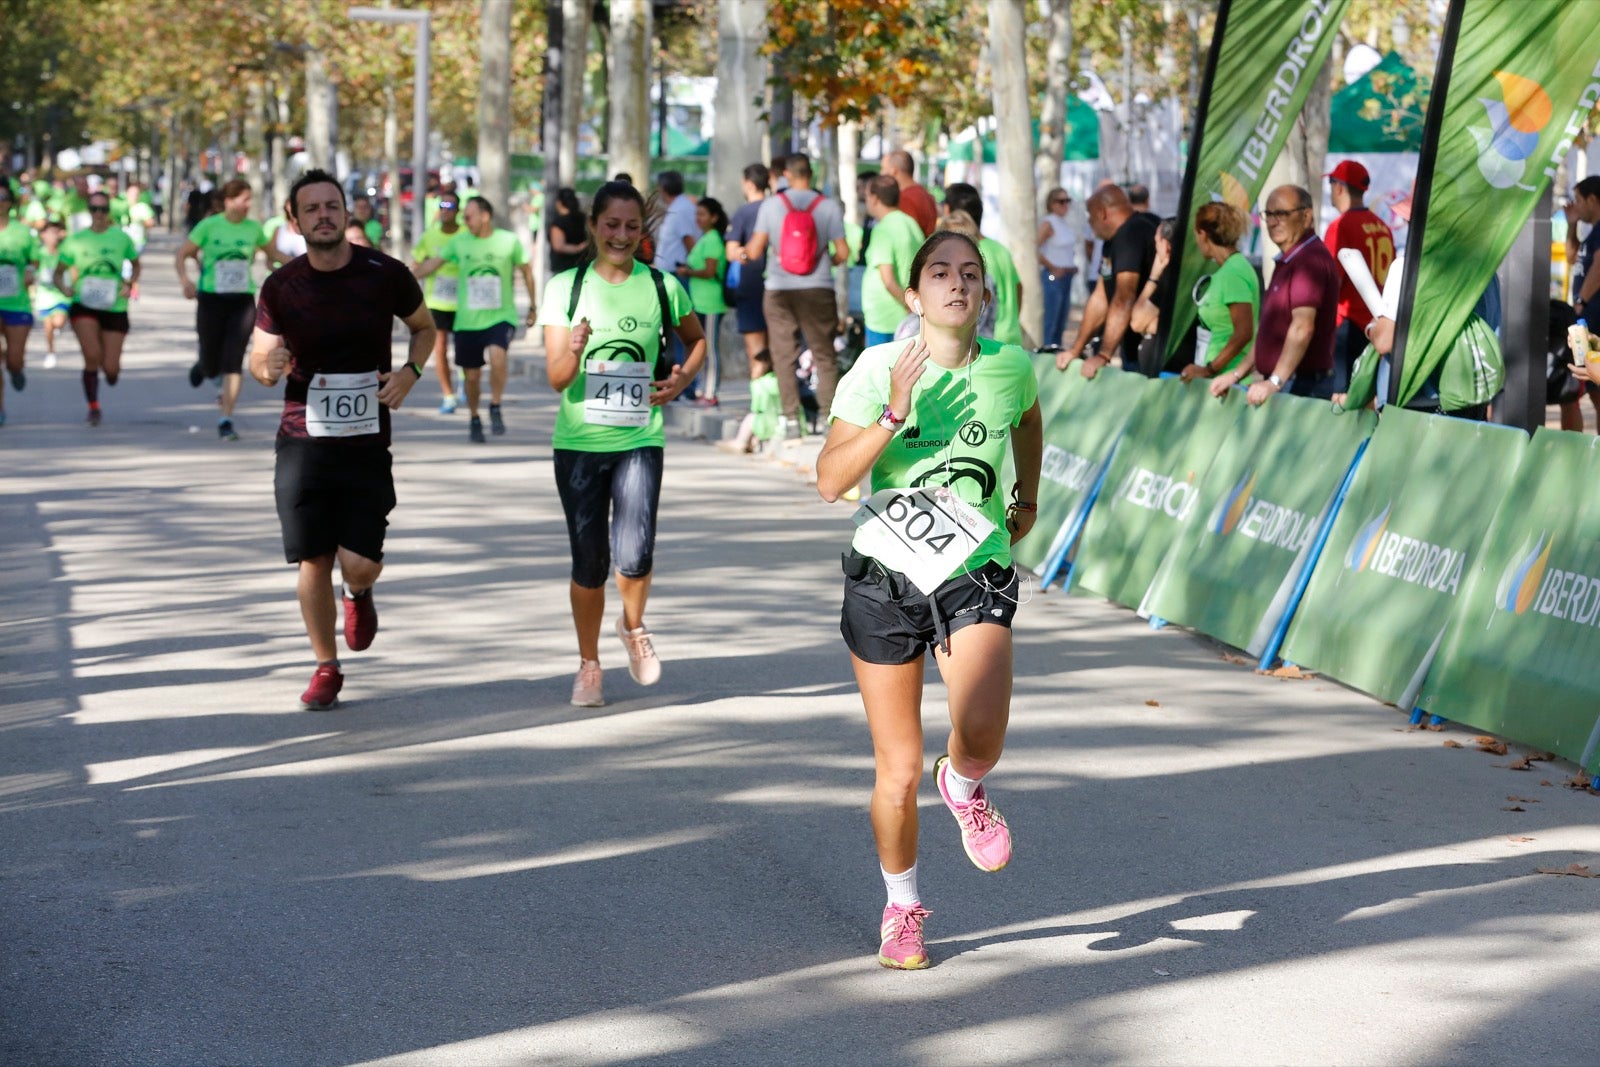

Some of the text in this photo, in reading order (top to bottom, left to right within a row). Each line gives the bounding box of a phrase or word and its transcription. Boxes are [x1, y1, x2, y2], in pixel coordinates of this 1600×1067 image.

[320, 393, 368, 418] 160
[594, 382, 643, 407] 419
[905, 439, 951, 449] IBERDROLA
[886, 493, 957, 556] 604
[1370, 530, 1466, 595] IBERDROLA
